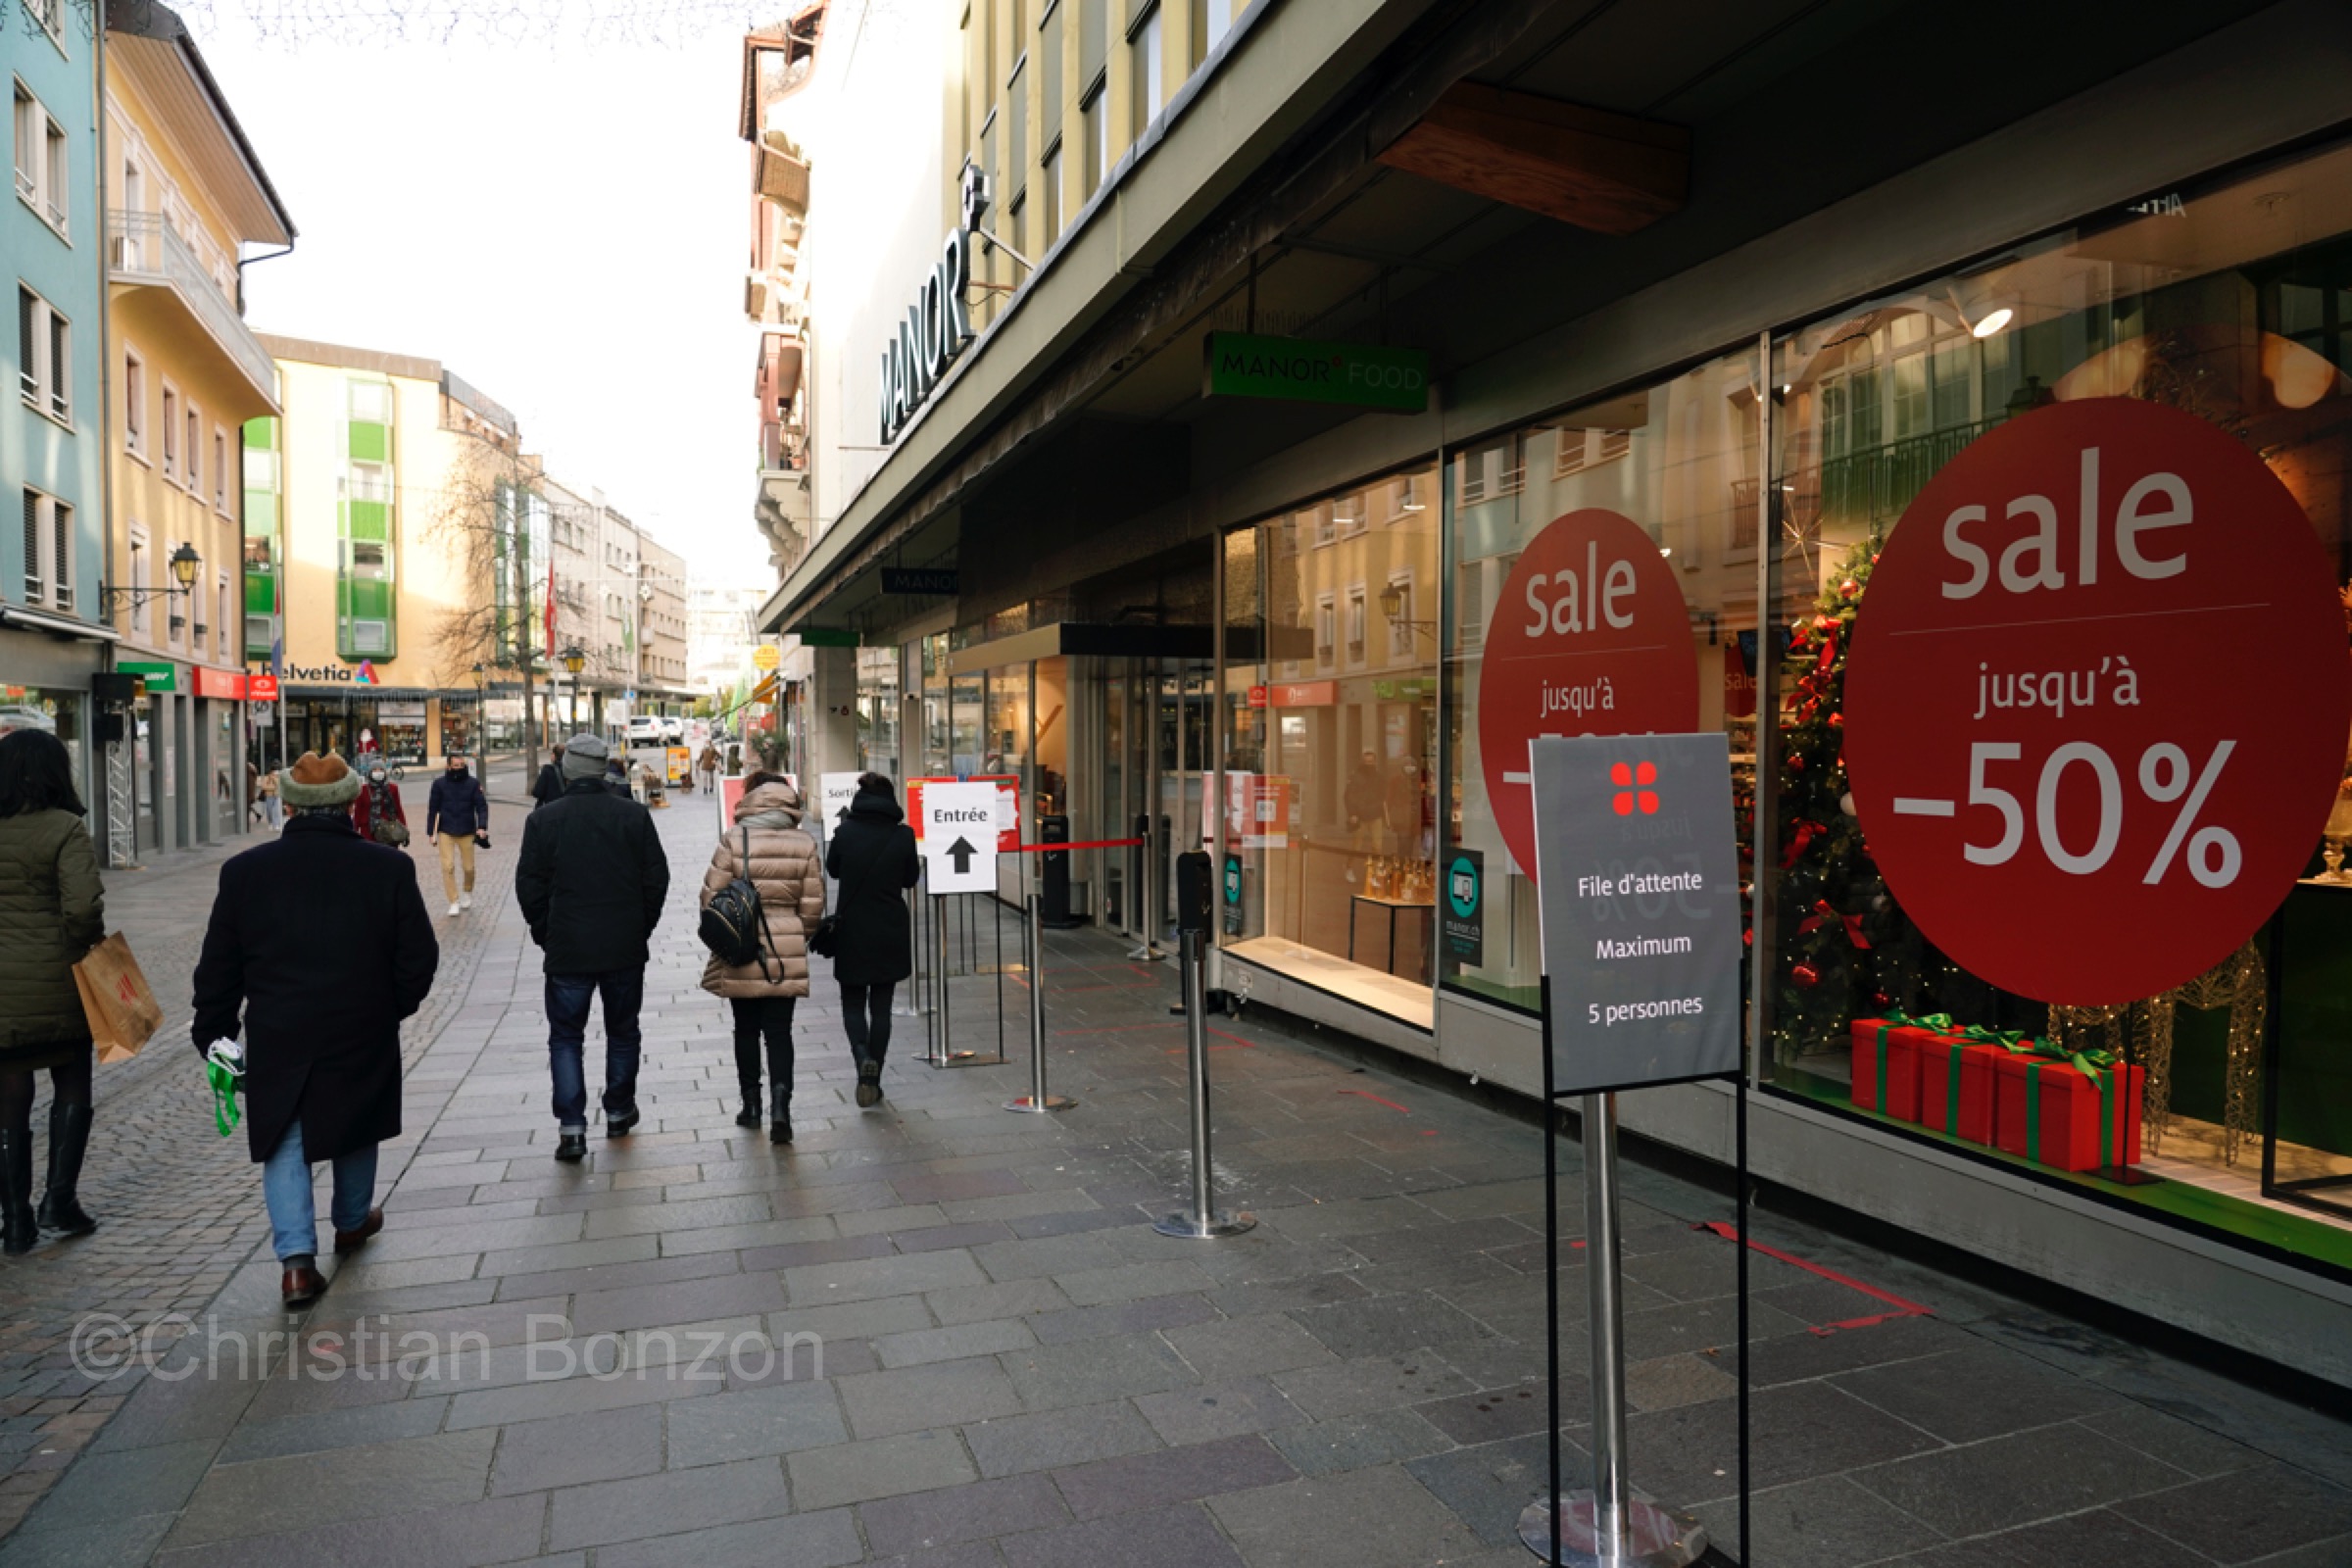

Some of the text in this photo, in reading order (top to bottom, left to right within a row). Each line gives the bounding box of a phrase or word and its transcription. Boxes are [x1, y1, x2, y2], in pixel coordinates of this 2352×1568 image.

[880, 227, 976, 445] MANOR
[1222, 353, 1422, 390] MANOR FOOD
[1941, 446, 2194, 600] sale
[1526, 541, 1637, 638] sale
[828, 788, 855, 798] Sorti
[933, 807, 989, 823] Entrée
[1578, 872, 1703, 898] File d'attente
[1595, 935, 1692, 959] Maximum
[1589, 997, 1704, 1027] 5 personnes
